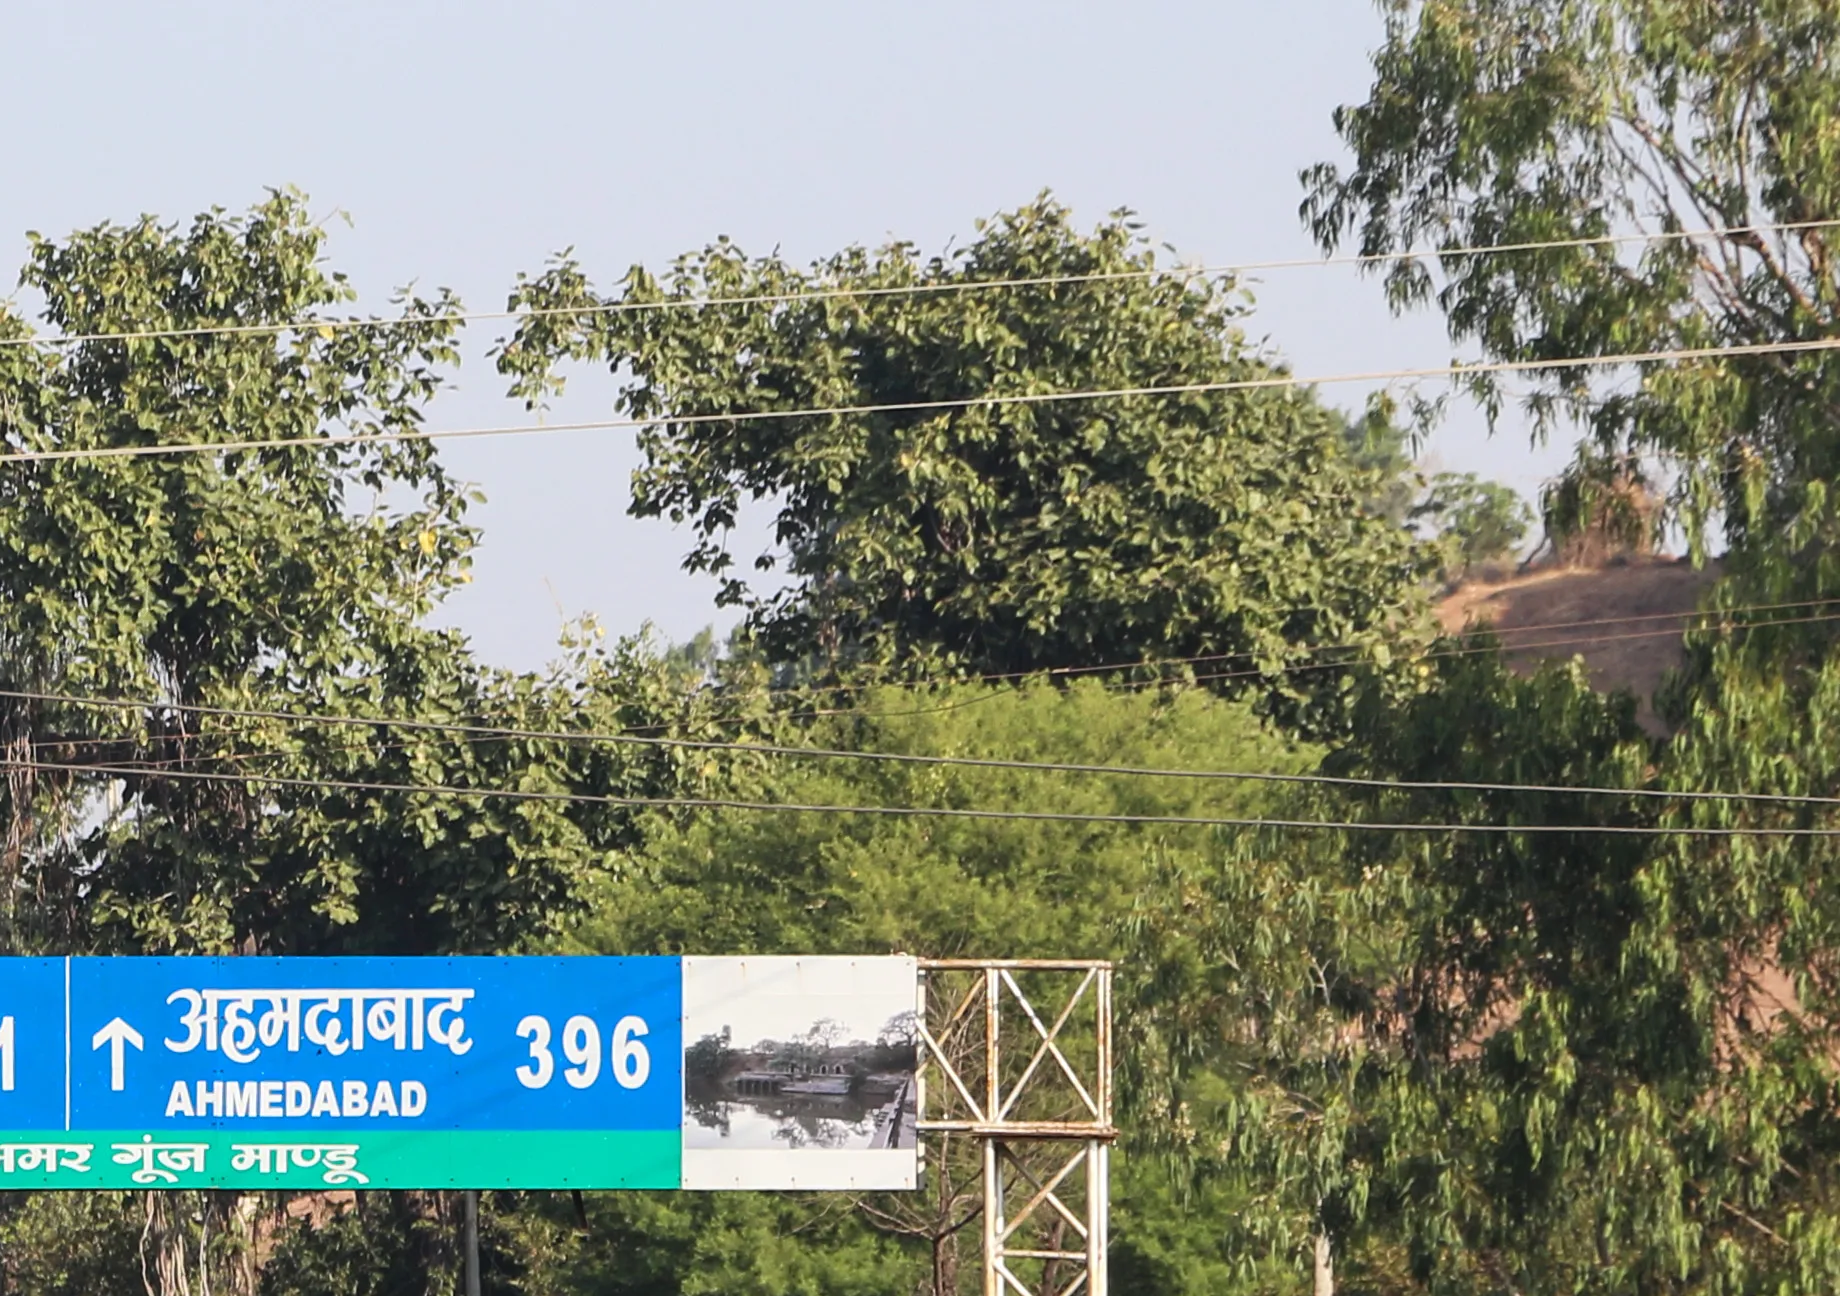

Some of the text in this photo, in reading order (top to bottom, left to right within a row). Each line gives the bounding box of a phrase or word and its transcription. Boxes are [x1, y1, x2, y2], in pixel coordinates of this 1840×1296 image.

[164, 988, 475, 1064] अहमदाबाद
[515, 1015, 650, 1089] 396
[165, 1080, 427, 1117] AHMEDABAD
[111, 1134, 210, 1183] गूंज
[231, 1144, 369, 1184] माण्डू
